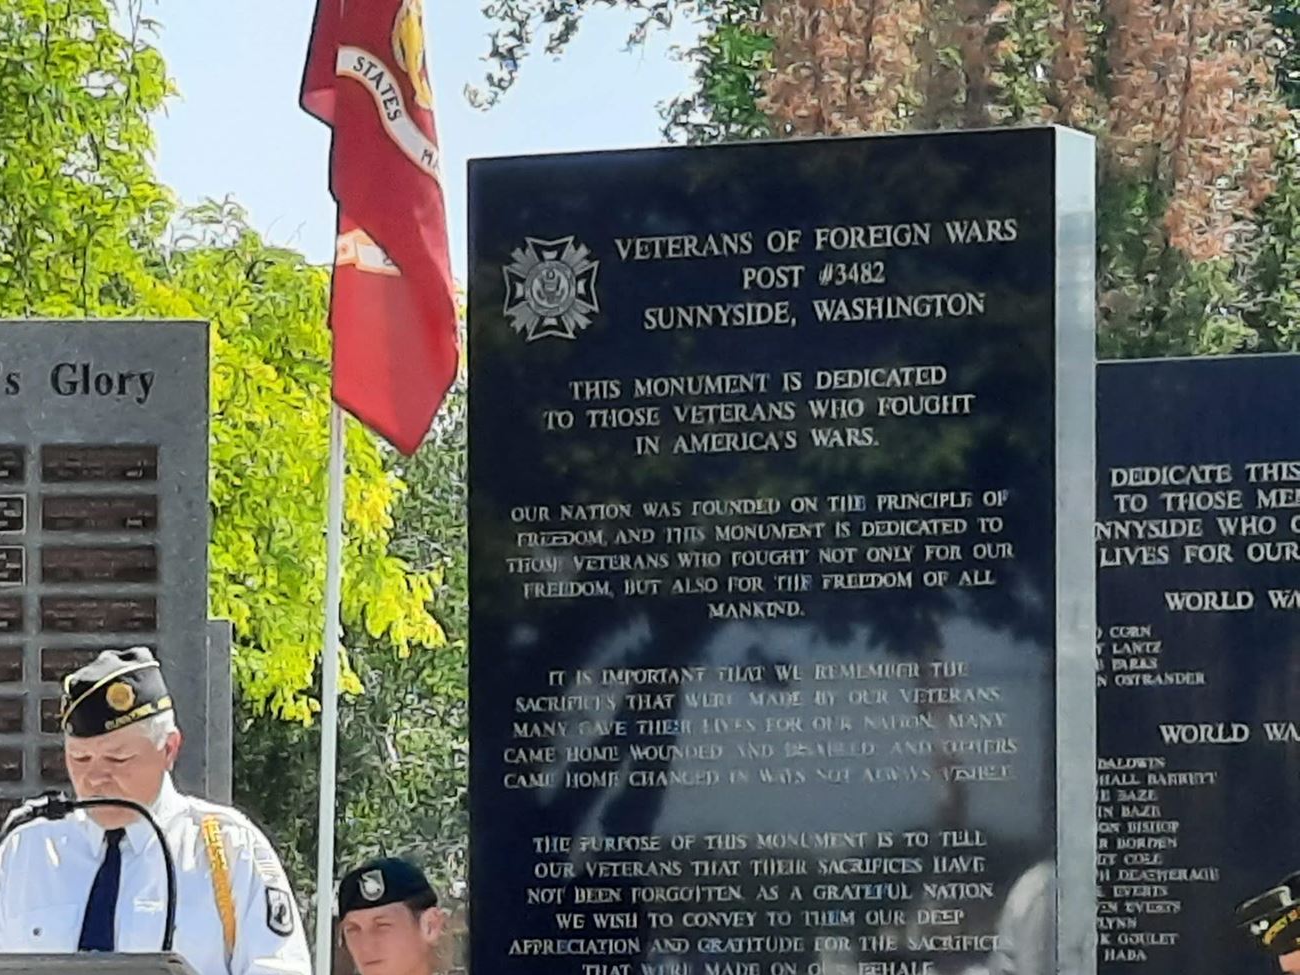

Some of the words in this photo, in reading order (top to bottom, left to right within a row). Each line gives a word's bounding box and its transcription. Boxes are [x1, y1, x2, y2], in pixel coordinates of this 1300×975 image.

[353, 56, 402, 122] STATES
[615, 233, 752, 261] VETERANS
[767, 231, 800, 253] OF
[815, 224, 930, 251] FOREIGN
[946, 220, 1017, 243] WARS
[743, 266, 805, 289] POST
[819, 262, 885, 285] #3482
[644, 302, 797, 330] SUNNYSIDE,
[814, 294, 985, 321] WASHINGTON
[50, 362, 156, 403] Glory
[570, 381, 620, 399] THIS
[634, 373, 769, 397] MONUMENT
[783, 373, 801, 391] IS
[816, 366, 946, 389] DEDICATED
[544, 411, 573, 430] TO
[587, 408, 660, 427] THOSE
[675, 404, 795, 424] VETERANS
[809, 400, 863, 419] WHO
[878, 395, 975, 416] FOUGHT
[635, 436, 660, 455] IN
[673, 431, 797, 453] AMERICA'S
[812, 429, 879, 448] WARS.
[1110, 464, 1232, 487] DEDICATE
[511, 506, 549, 522] OUR
[560, 504, 632, 521] NATION
[643, 502, 680, 518] WAS
[692, 499, 780, 515] FOUNDED
[791, 497, 817, 513] ON
[828, 495, 865, 512] THE
[877, 492, 971, 510] PRINCIPLE
[983, 491, 1008, 507] OF
[1113, 493, 1147, 513] TO
[1160, 491, 1243, 511] THOSE
[615, 528, 654, 544] AND
[715, 523, 824, 540] MONUMENT
[835, 521, 850, 538] IS
[862, 519, 967, 536] DEDICATED
[978, 517, 1003, 532] TO
[1217, 516, 1276, 536] WHO
[573, 554, 668, 570] VETERANS
[678, 552, 721, 568] WHO
[732, 550, 809, 567] FOUGHT
[819, 548, 857, 564] NOT
[867, 546, 914, 562] ONLY
[925, 545, 963, 560] FOR
[973, 543, 1014, 559] OUR
[1100, 545, 1169, 568] LIVES
[1185, 544, 1233, 564] FOR
[1247, 542, 1300, 563] OUR
[624, 579, 661, 595] BUT
[672, 578, 718, 594] ALSO
[728, 577, 763, 593] FOR
[822, 572, 912, 590] FREEDOM
[924, 571, 948, 586] OF
[959, 570, 995, 585] ALL
[1164, 591, 1253, 612] WORLD
[576, 669, 592, 685] IS
[602, 667, 705, 685] IMPORTANT
[626, 693, 674, 710] THAT
[513, 721, 567, 738] MANY
[1159, 724, 1249, 744] WORLD
[504, 747, 555, 764] CAME
[630, 744, 723, 761] WOUNDED
[533, 836, 571, 853] THE
[579, 836, 660, 852] PURPOSE
[671, 834, 695, 850] OF
[705, 834, 747, 850] THIS
[757, 831, 867, 850] MONUMENT
[878, 831, 893, 848] IS
[904, 831, 928, 847] TO
[534, 863, 575, 878] OUR
[586, 861, 682, 877] VETERANS
[691, 861, 741, 876] THAT
[819, 858, 922, 874] SACRIFICES
[527, 888, 565, 904] NOT
[575, 888, 621, 903] BEEN
[757, 885, 779, 901] AS
[790, 885, 803, 900] A
[814, 882, 912, 900] GRATEFUL
[923, 882, 993, 899] NATION
[556, 913, 584, 929] WE
[594, 913, 637, 928] WISH
[648, 912, 673, 927] TO
[683, 912, 756, 927] CONVEY
[766, 911, 791, 926] TO
[804, 910, 854, 926] THEM
[866, 910, 905, 925] OUR
[918, 909, 964, 925] DEEP
[508, 938, 640, 955] APPRECIATION
[651, 938, 689, 953] AND
[698, 936, 804, 953] GRATITUDE
[815, 936, 851, 951] FOR
[859, 936, 897, 951] THE
